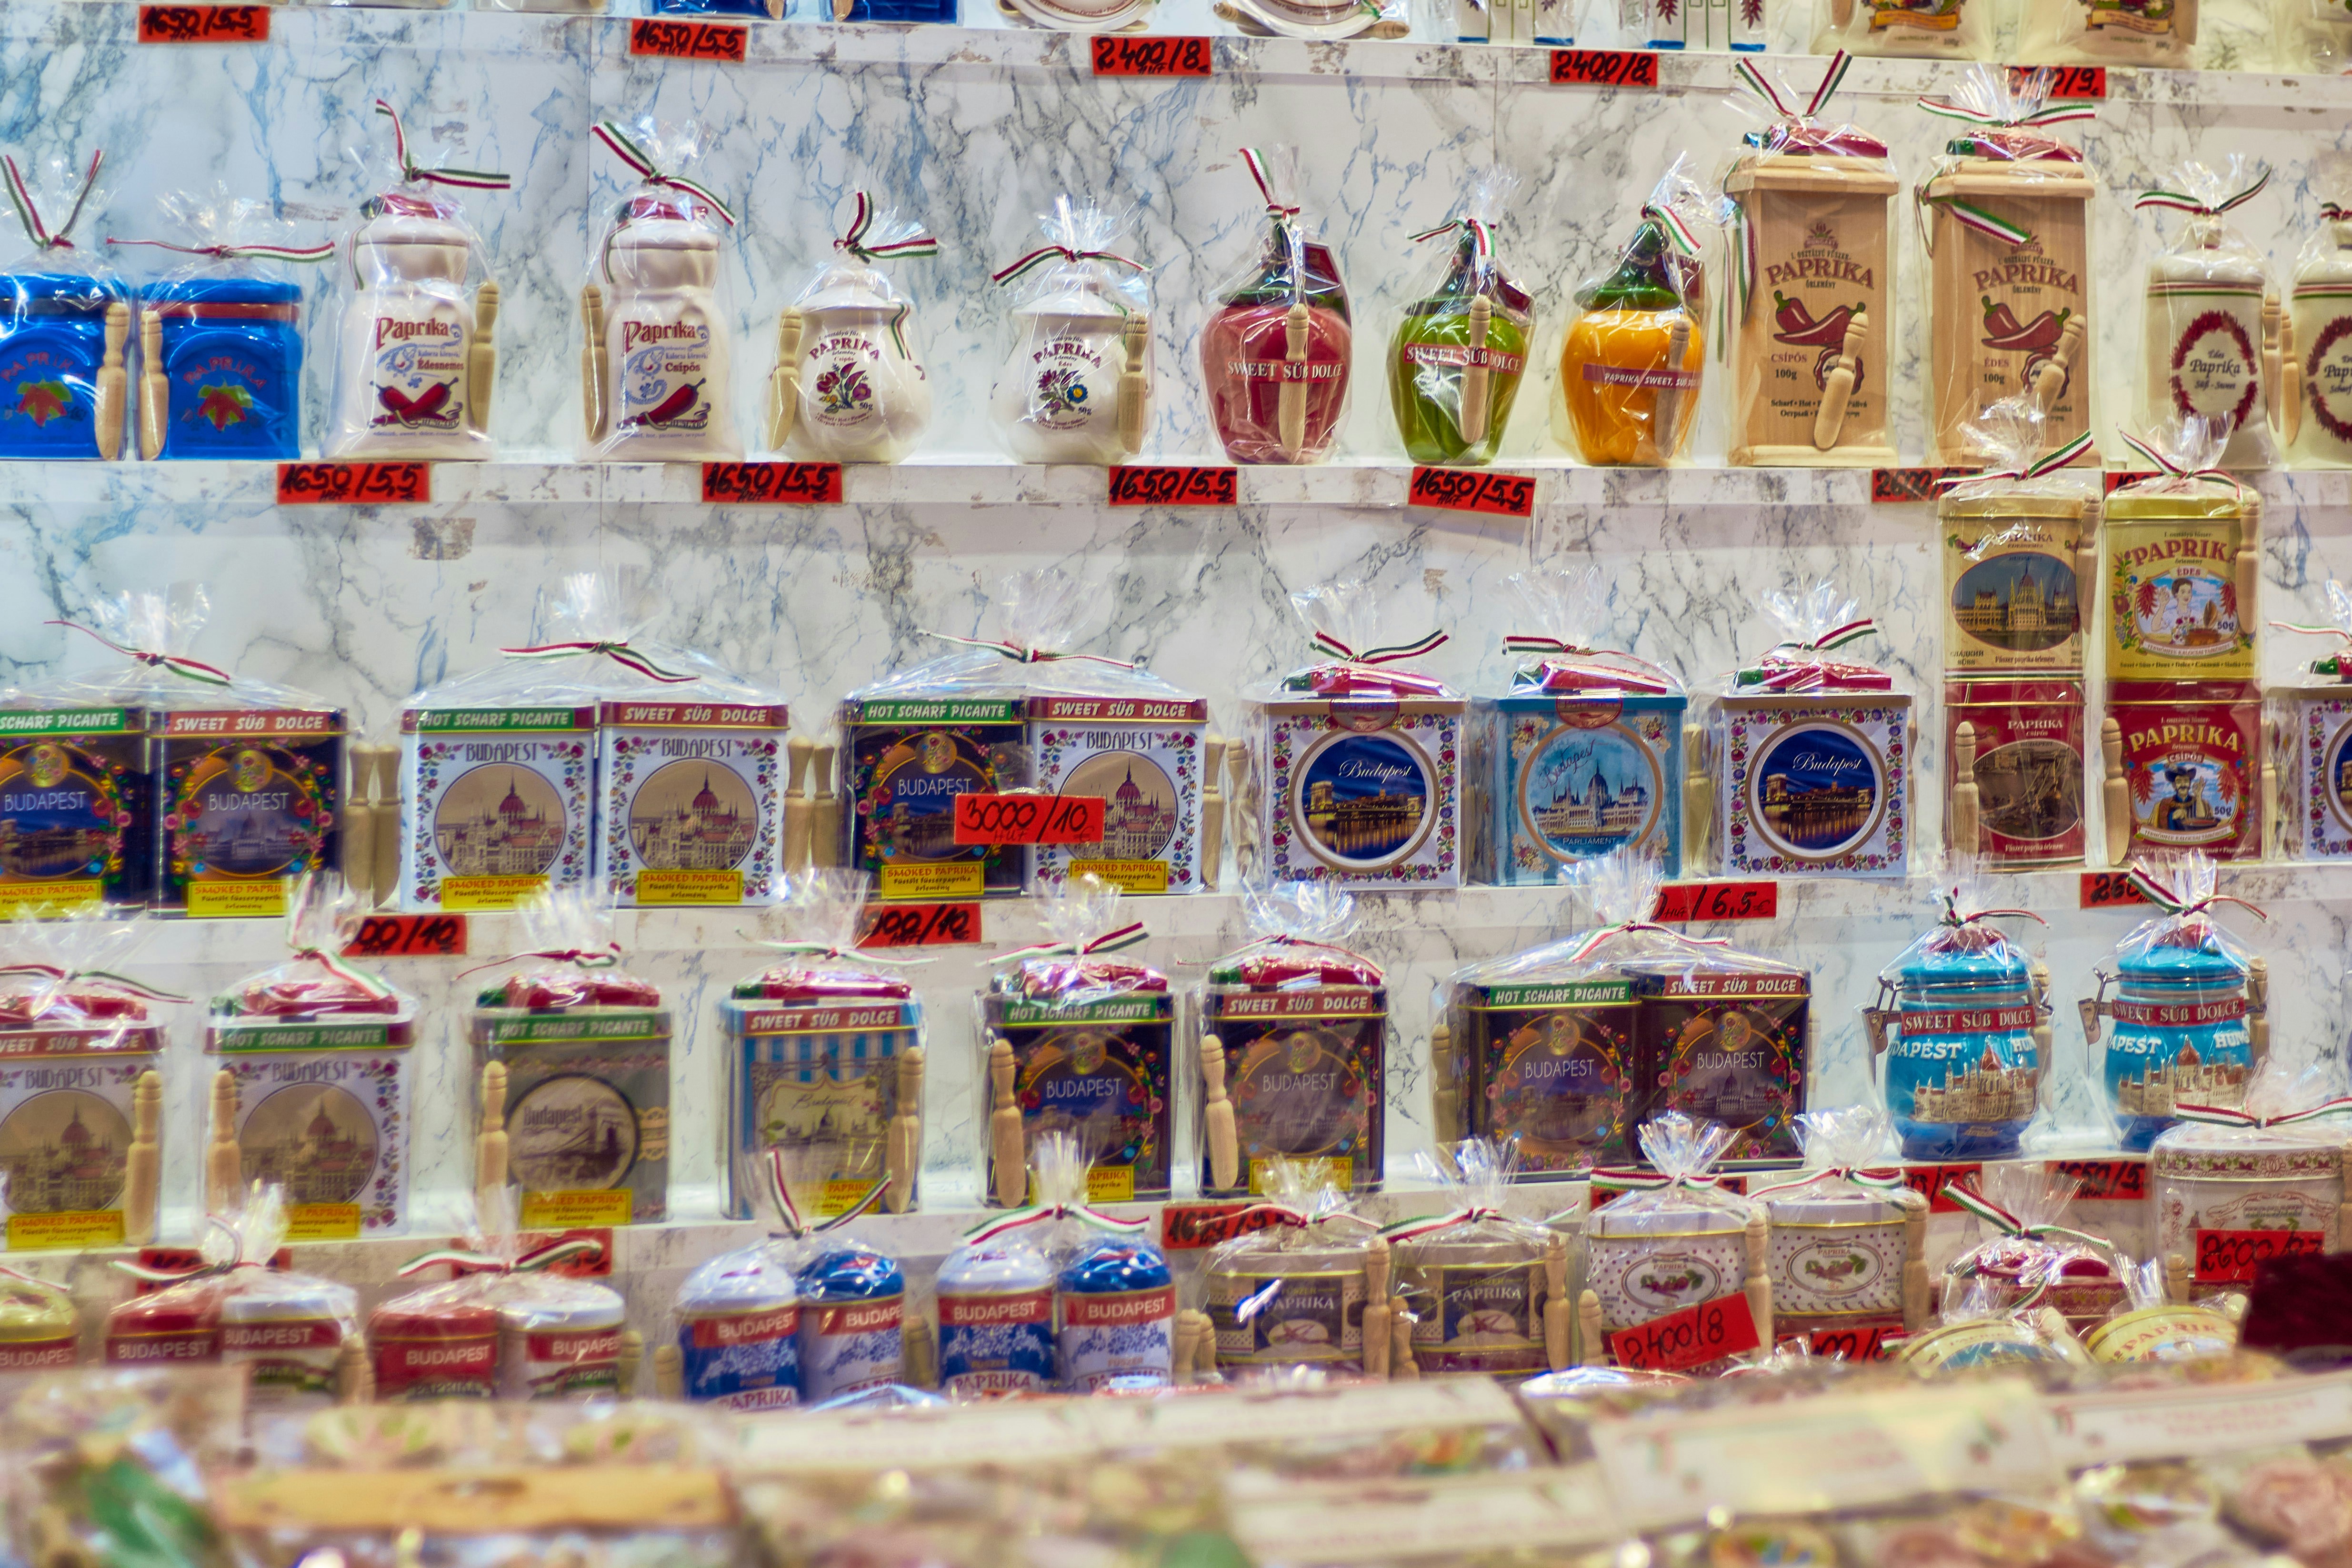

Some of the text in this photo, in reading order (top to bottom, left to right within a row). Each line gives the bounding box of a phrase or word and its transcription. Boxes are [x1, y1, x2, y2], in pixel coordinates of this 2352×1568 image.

[1765, 258, 1874, 290] PAPRIKA
[1972, 263, 2079, 296] PAPRIKA
[374, 317, 450, 352] Paprika
[621, 320, 696, 355] Paprika
[809, 337, 881, 361] PAPRIKA
[1032, 342, 1102, 369] PAPRIKA
[1406, 346, 1456, 362] SWEET
[1, 351, 86, 382] PAPRIKA
[417, 356, 464, 370] Édesnemes
[665, 361, 701, 375] Csípős
[1227, 361, 1278, 379] SWEET
[1312, 363, 1344, 380] DOLCE
[2190, 359, 2241, 379] Paprika
[183, 356, 267, 390] PAPRIKA
[1604, 372, 1639, 383] PAPRIKA
[1775, 368, 1797, 380] 100g
[1984, 373, 2005, 385] 100g
[2131, 539, 2240, 567] PAPRIKA
[2176, 566, 2202, 577] ÉDES
[2217, 620, 2234, 631] 50g
[422, 711, 570, 727] HOT SCHARF PICANTE
[624, 707, 674, 722] SWEET
[720, 708, 767, 722] DOLCE
[868, 704, 1007, 719] HOT SCHARF PICANTE
[1051, 702, 1100, 716] SWEET
[1143, 702, 1186, 717] DOLCE
[57, 713, 119, 727] PICANTE
[174, 718, 227, 731] SWEET
[275, 716, 323, 730] DOLCE
[2007, 719, 2063, 729] PAPRIKA
[661, 738, 733, 758] BUDAPEST
[1086, 731, 1154, 750] BUDAPEST
[2129, 725, 2239, 753] PAPRIKA
[465, 742, 538, 762] BUDAPEST
[1338, 759, 1412, 784] Budapest
[1538, 739, 1596, 789] Budapest
[1792, 752, 1863, 777] Budapest
[898, 778, 972, 797] BUDAPEST
[4, 790, 87, 811] BUDAPEST
[209, 792, 289, 811] BUDAPEST
[961, 795, 1089, 842] 3000/10
[2214, 806, 2232, 817] 50g
[1562, 836, 1617, 846] PARLIAMENT
[887, 866, 977, 877] SMOKED PAPRIKA
[1074, 863, 1162, 872] SMOKED PAPRIKA
[448, 879, 495, 889] SMOKED
[643, 874, 736, 883] SMOKED PAPRIKA
[48, 885, 95, 894] PAPRIKA
[195, 885, 243, 895] SMOKED
[1495, 987, 1626, 1005] HOT SCHARF PICANTE
[1670, 980, 1715, 994] SWEET
[1756, 979, 1797, 992] DOLCE
[1009, 1003, 1151, 1021] HOT SCHARF PICANTE
[1229, 998, 1279, 1014] SWEET
[1323, 996, 1368, 1011] DOLCE
[2113, 1002, 2155, 1021] SWEET
[2197, 999, 2241, 1020] DOLCE
[500, 1019, 651, 1039] HOT SCHARF PICANTE
[750, 1014, 801, 1030] SWEET
[848, 1010, 897, 1028] DOLCE
[1905, 1013, 1956, 1031] SWEET
[2000, 1009, 2032, 1027] DOLCE
[226, 1028, 382, 1047] HOT SCHARF PICANTE
[1525, 1059, 1595, 1078] BUDAPEST
[1697, 1051, 1765, 1069] BUDAPEST
[25, 1067, 103, 1090] BUDAPEST
[272, 1060, 350, 1082] BUDAPEST
[1046, 1078, 1122, 1099] BUDAPEST
[1262, 1073, 1337, 1091] BUDAPEST
[791, 1093, 858, 1115] Budapest
[523, 1103, 582, 1129] Budapest
[577, 1195, 624, 1205] PAPRIKA
[14, 1215, 117, 1228] SMOKED PAPRIKA
[1452, 1287, 1522, 1303] PAPRIKA
[953, 1300, 1038, 1321] BUDAPEST
[1088, 1297, 1166, 1319] BUDAPEST
[717, 1311, 796, 1338] BUDAPEST
[225, 1327, 312, 1345] BUDAPEST
[118, 1340, 210, 1360] BUDAPEST
[406, 1345, 490, 1365] BUDAPEST
[955, 1372, 1031, 1389] PAPRIKA
